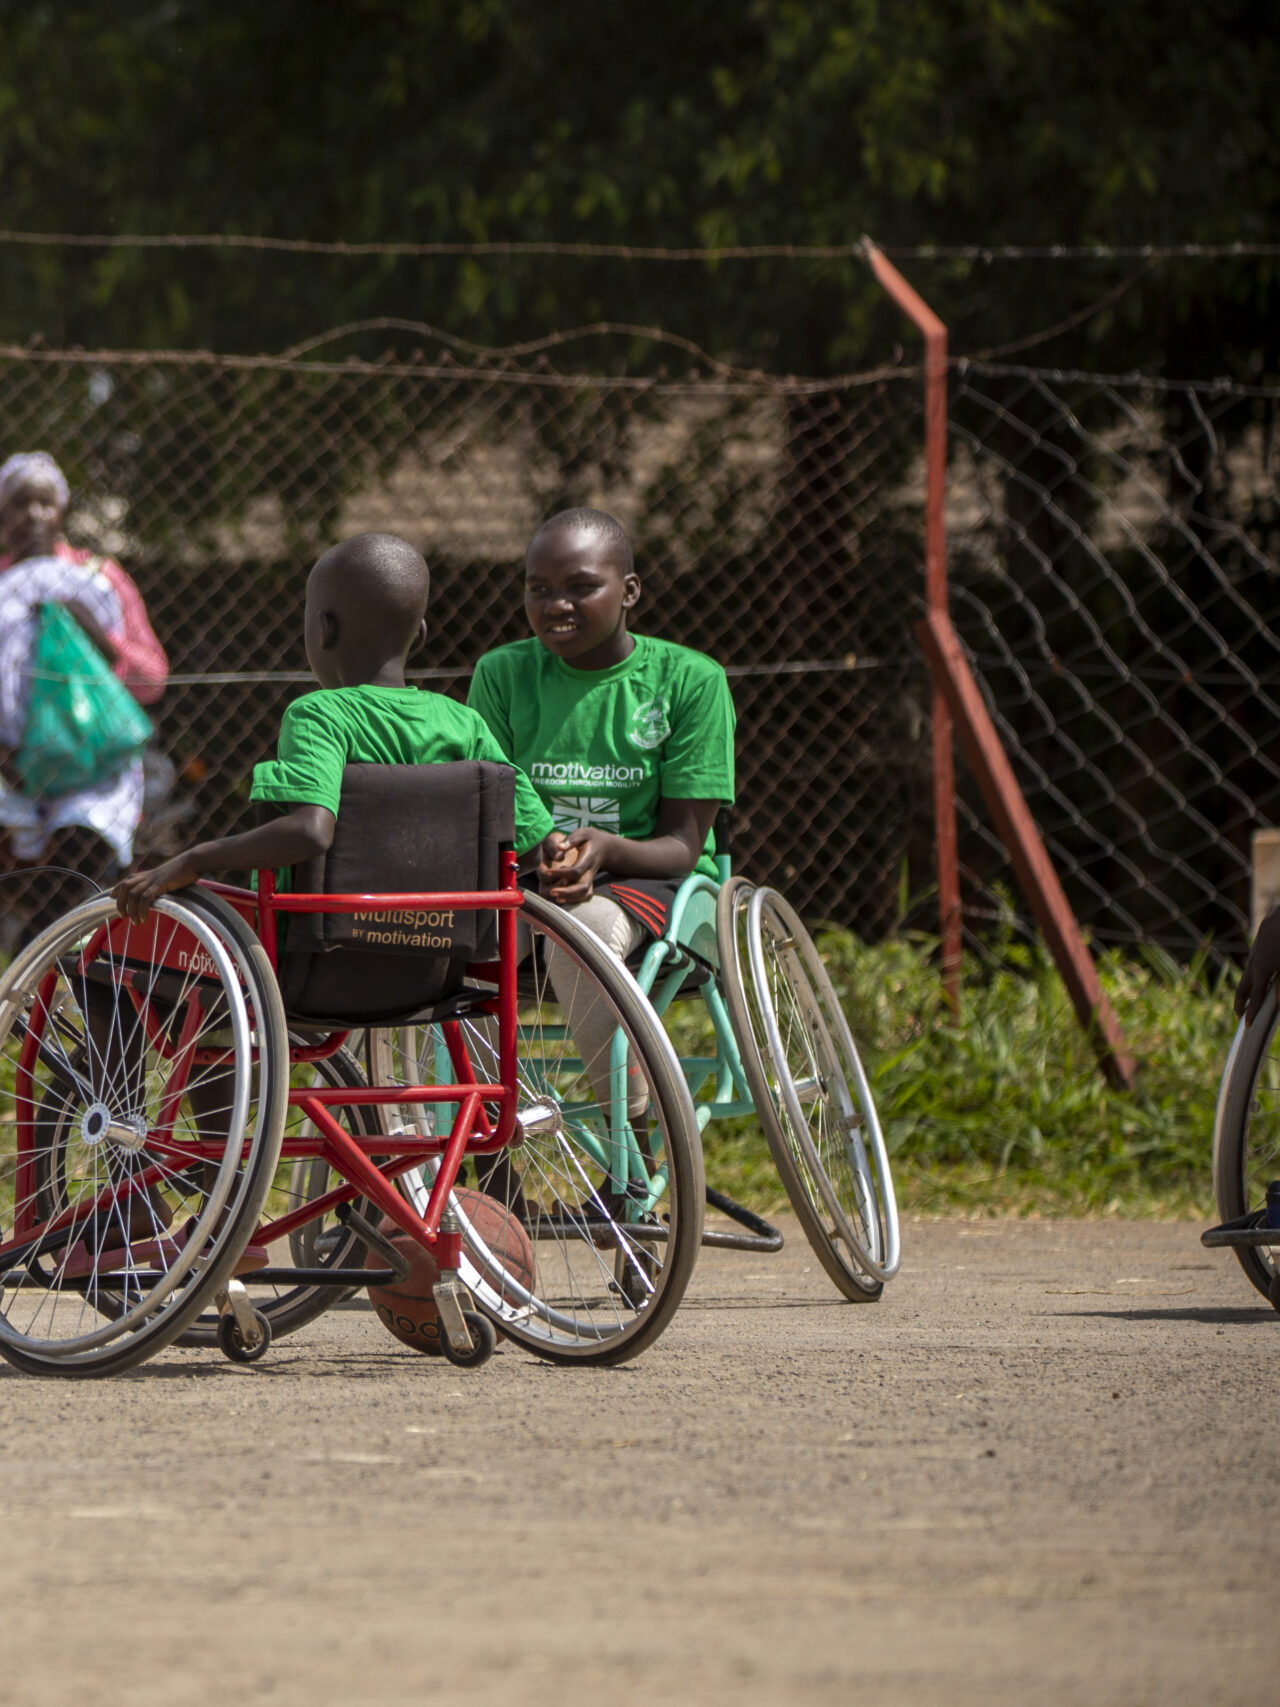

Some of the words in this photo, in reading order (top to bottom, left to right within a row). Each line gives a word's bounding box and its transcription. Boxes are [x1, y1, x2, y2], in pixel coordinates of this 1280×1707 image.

[530, 762, 644, 781] motivation
[531, 778, 567, 786] FREEDOM
[569, 778, 604, 787] THROUGH
[606, 780, 641, 789] MOBILITY
[352, 928, 365, 938] BY
[367, 930, 452, 949] motivation
